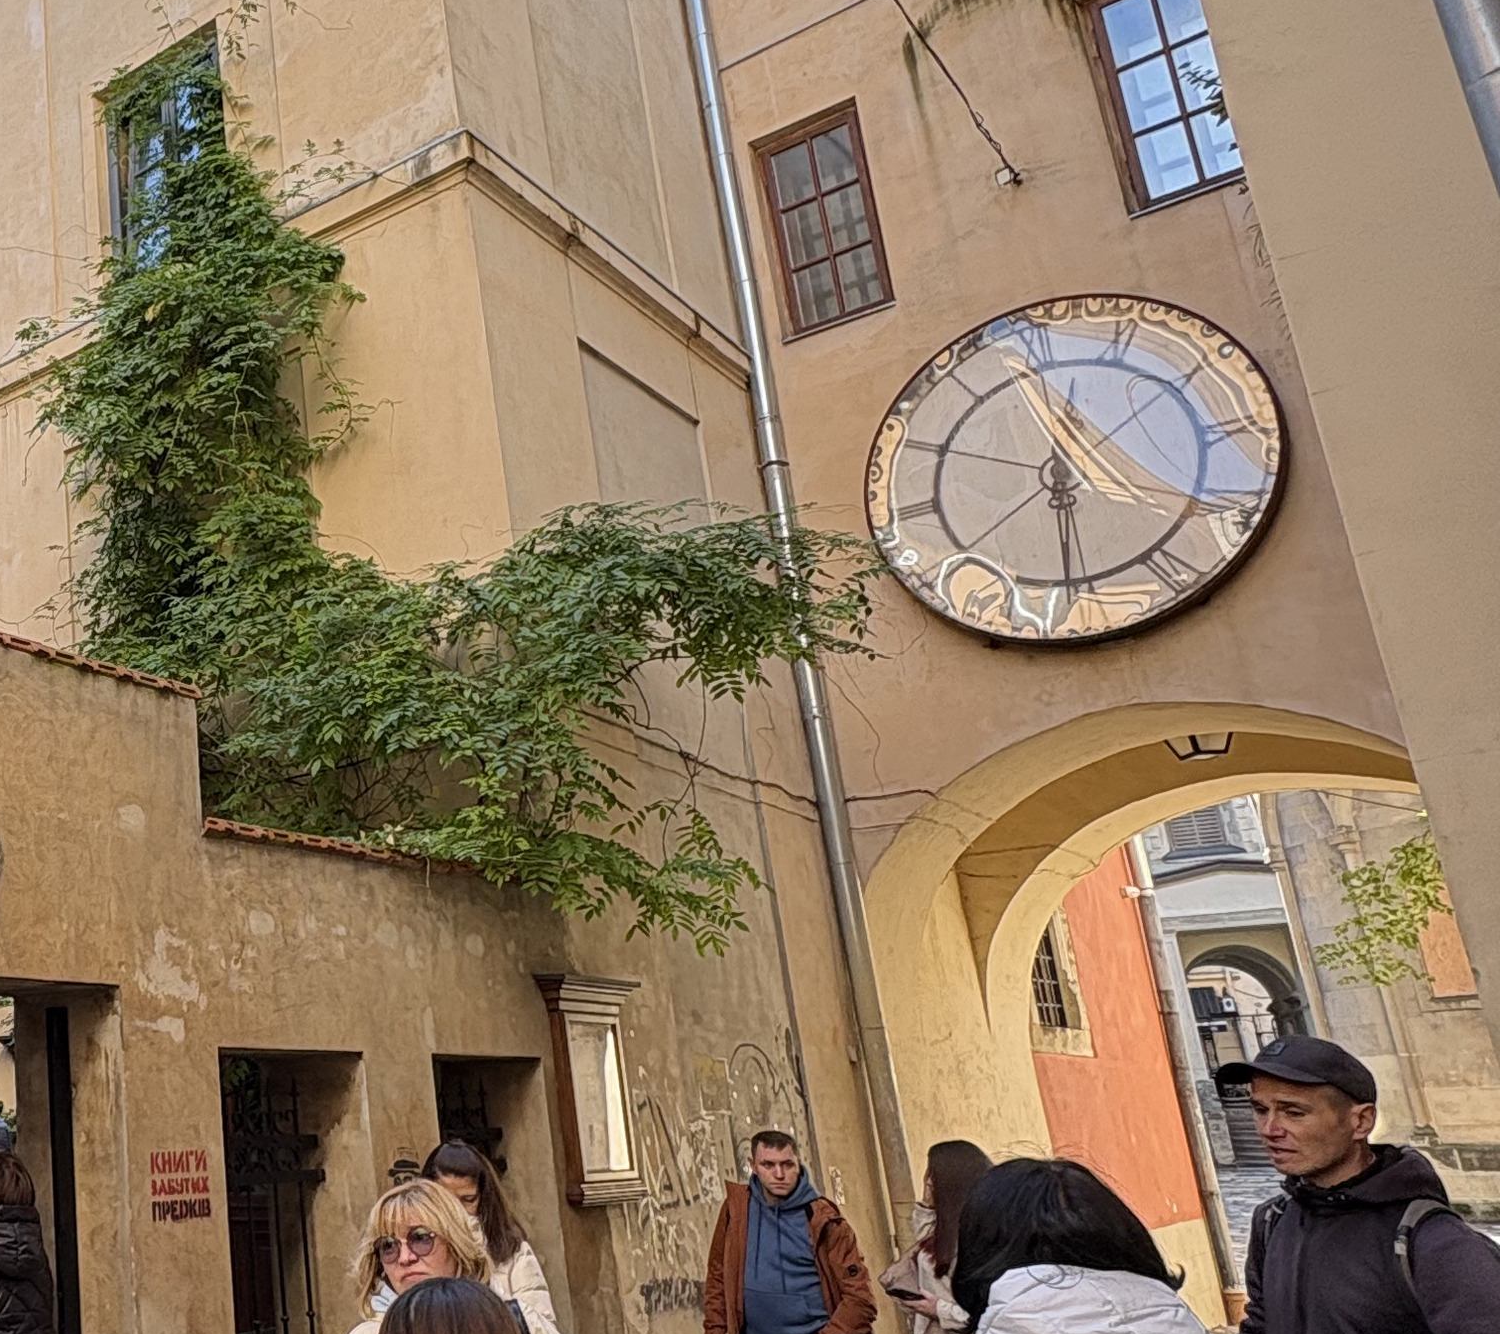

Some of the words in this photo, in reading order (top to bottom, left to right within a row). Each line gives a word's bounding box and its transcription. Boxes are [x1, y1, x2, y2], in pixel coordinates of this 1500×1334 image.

[150, 1149, 207, 1175] КНИГИ
[151, 1176, 209, 1196] ЗАБУТИХ
[152, 1198, 211, 1223] ПРЕДКІВ
